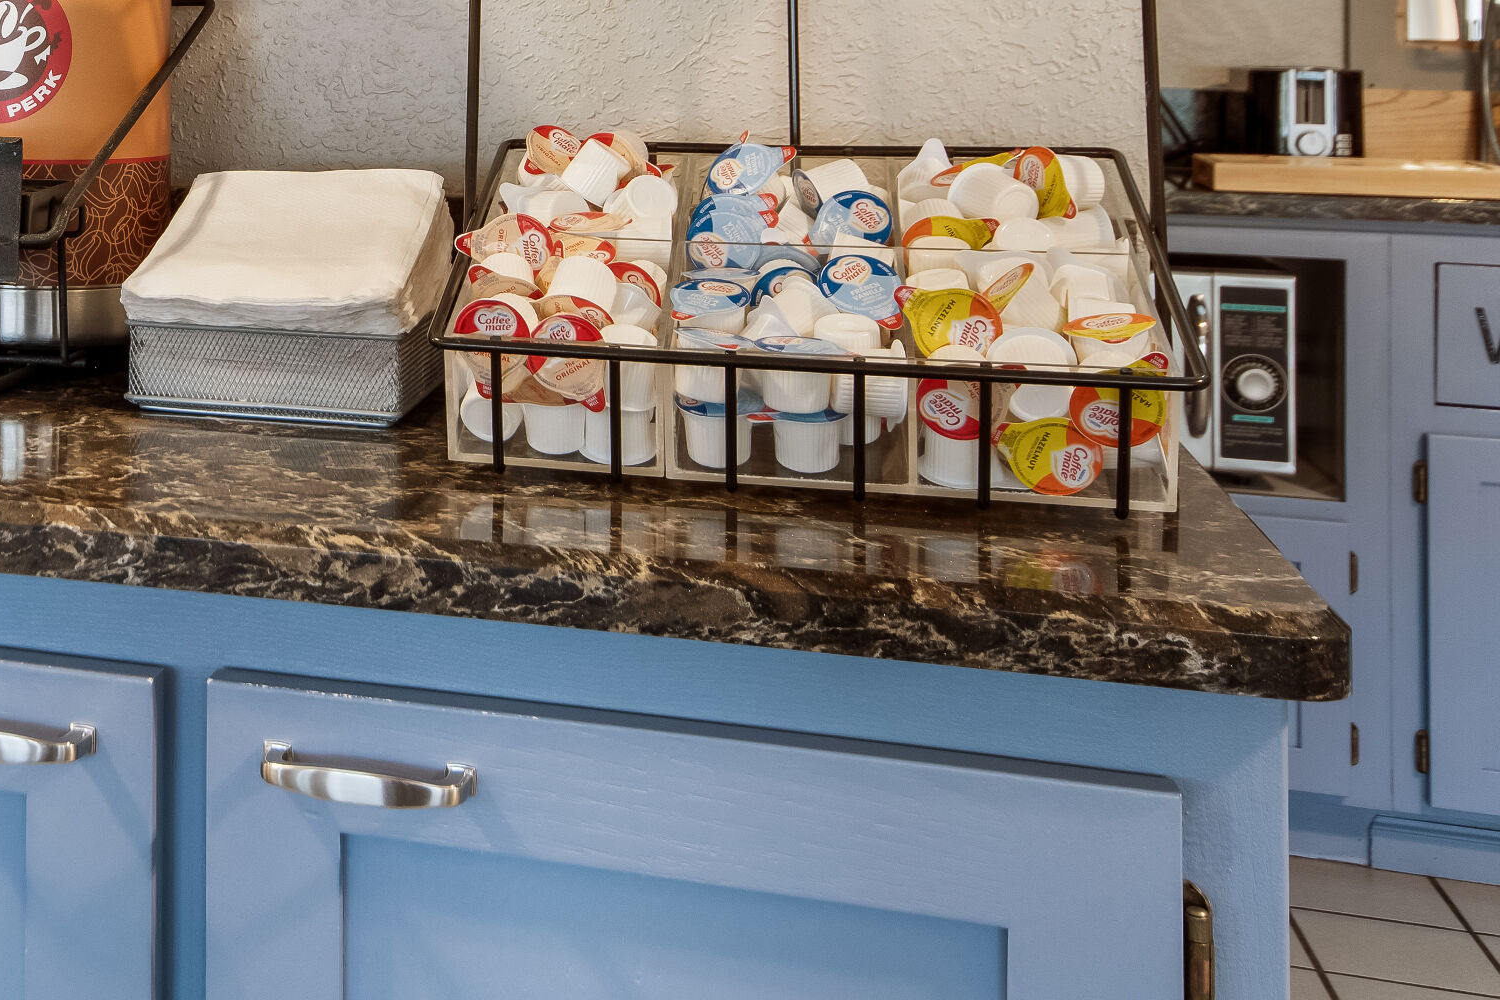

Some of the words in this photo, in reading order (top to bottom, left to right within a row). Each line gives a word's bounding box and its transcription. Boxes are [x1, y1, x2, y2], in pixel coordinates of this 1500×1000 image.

[6, 69, 62, 118] PERK
[853, 210, 876, 230] mate
[855, 201, 881, 226] Coffee
[528, 233, 541, 264] Coffee
[832, 262, 862, 281] Coffee
[844, 267, 867, 282] mate
[477, 313, 511, 325] Coffee
[928, 298, 957, 337] HAZELNUT
[959, 321, 973, 346] mat
[965, 319, 988, 348] Coffee
[555, 359, 591, 381] ORIGINAL
[929, 399, 961, 426] Coffee
[933, 393, 963, 414] mate
[1028, 431, 1051, 471] HAZELNUT
[1069, 447, 1088, 481] Coffee
[1060, 450, 1073, 480] mate
